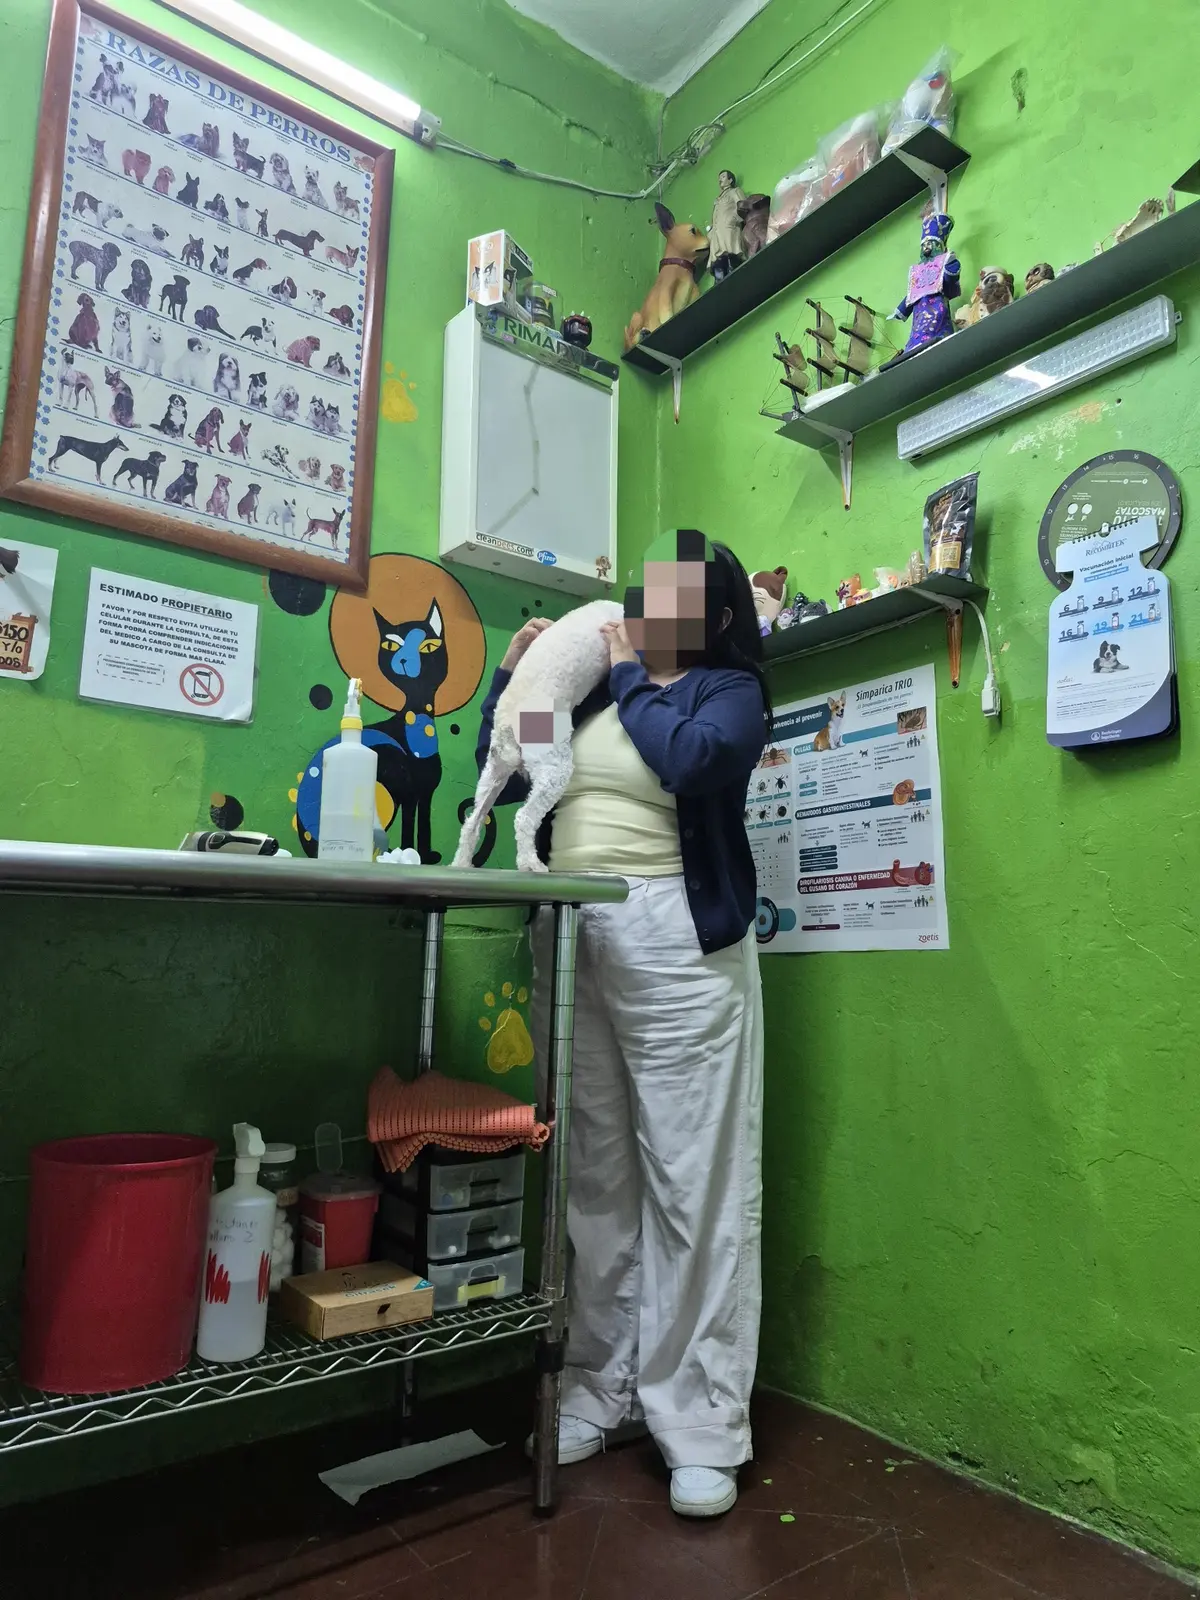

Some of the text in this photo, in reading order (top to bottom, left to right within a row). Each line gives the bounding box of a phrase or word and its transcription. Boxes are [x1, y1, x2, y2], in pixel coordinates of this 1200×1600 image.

[107, 31, 351, 162] RAZAS DE PERROS
[1115, 507, 1166, 515] MASCOTA?
[1080, 553, 1133, 572] Vacunación inicial
[1130, 586, 1143, 596] 12
[99, 583, 232, 619] ESTIMADO PROPIETARIO
[101, 603, 124, 612] FAVOR
[148, 613, 177, 624] RESPETO
[179, 619, 197, 628] EVITA
[199, 624, 227, 634] UTILIZAR
[1130, 612, 1143, 621] 21
[100, 611, 131, 622] CELULAR
[132, 618, 163, 629] DURANTE
[222, 636, 238, 644] ESTA
[1060, 628, 1073, 637] 16
[1094, 621, 1107, 630] 19
[98, 619, 122, 628] FORMA
[148, 629, 192, 643] COMPRENDER
[194, 638, 238, 652] INDICACIONES
[120, 640, 152, 651] MASCOTA
[164, 649, 187, 658] FORMA
[148, 637, 171, 646] CARGO
[193, 646, 226, 657] CONSULTA
[856, 685, 893, 702] Simparica
[895, 678, 913, 691] TRIO
[801, 711, 823, 723] prevenir
[794, 744, 811, 753] PULGAS
[822, 800, 871, 814] GASTROINTESTINALES
[800, 878, 834, 886] DIROFILARIOSIS
[835, 875, 852, 883] CANINA
[858, 871, 891, 880] ENFERMEDAD
[835, 881, 858, 890] CORAZÓN
[918, 933, 939, 943] zoetis
